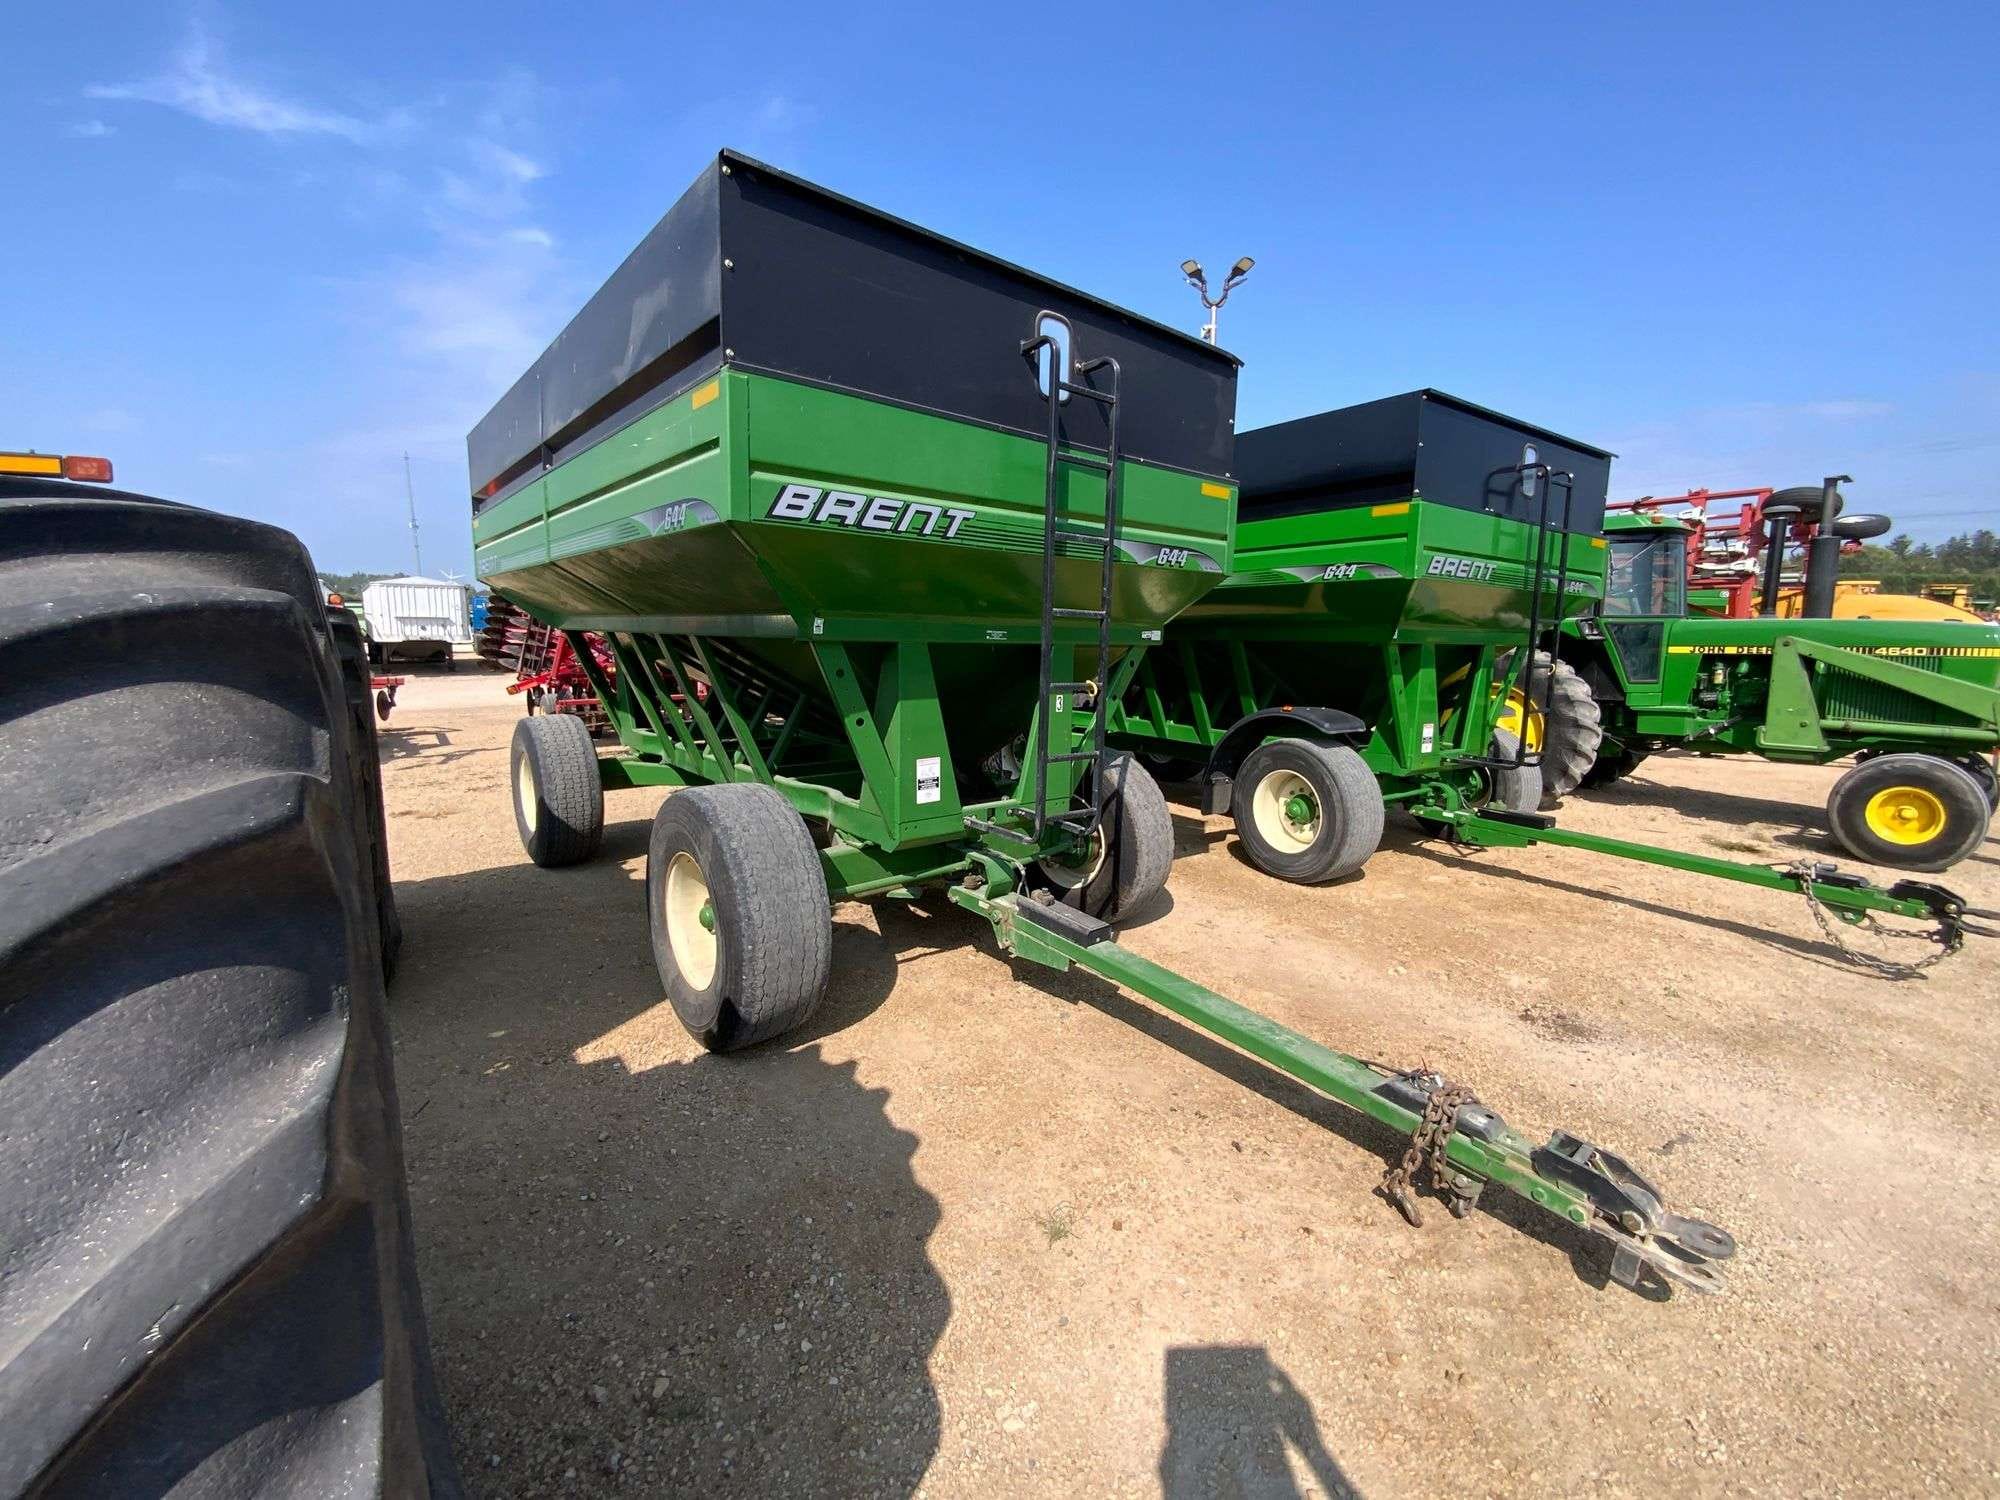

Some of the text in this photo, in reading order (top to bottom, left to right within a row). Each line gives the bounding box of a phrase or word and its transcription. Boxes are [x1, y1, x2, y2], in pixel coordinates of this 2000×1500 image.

[664, 502, 687, 531] 644
[766, 483, 977, 539] BRENT
[1156, 546, 1189, 568] 644
[1426, 554, 1497, 581] BRENT
[1323, 563, 1358, 580] 644
[1688, 645, 1773, 655] JOHN DEER
[1874, 646, 1927, 657] 4640
